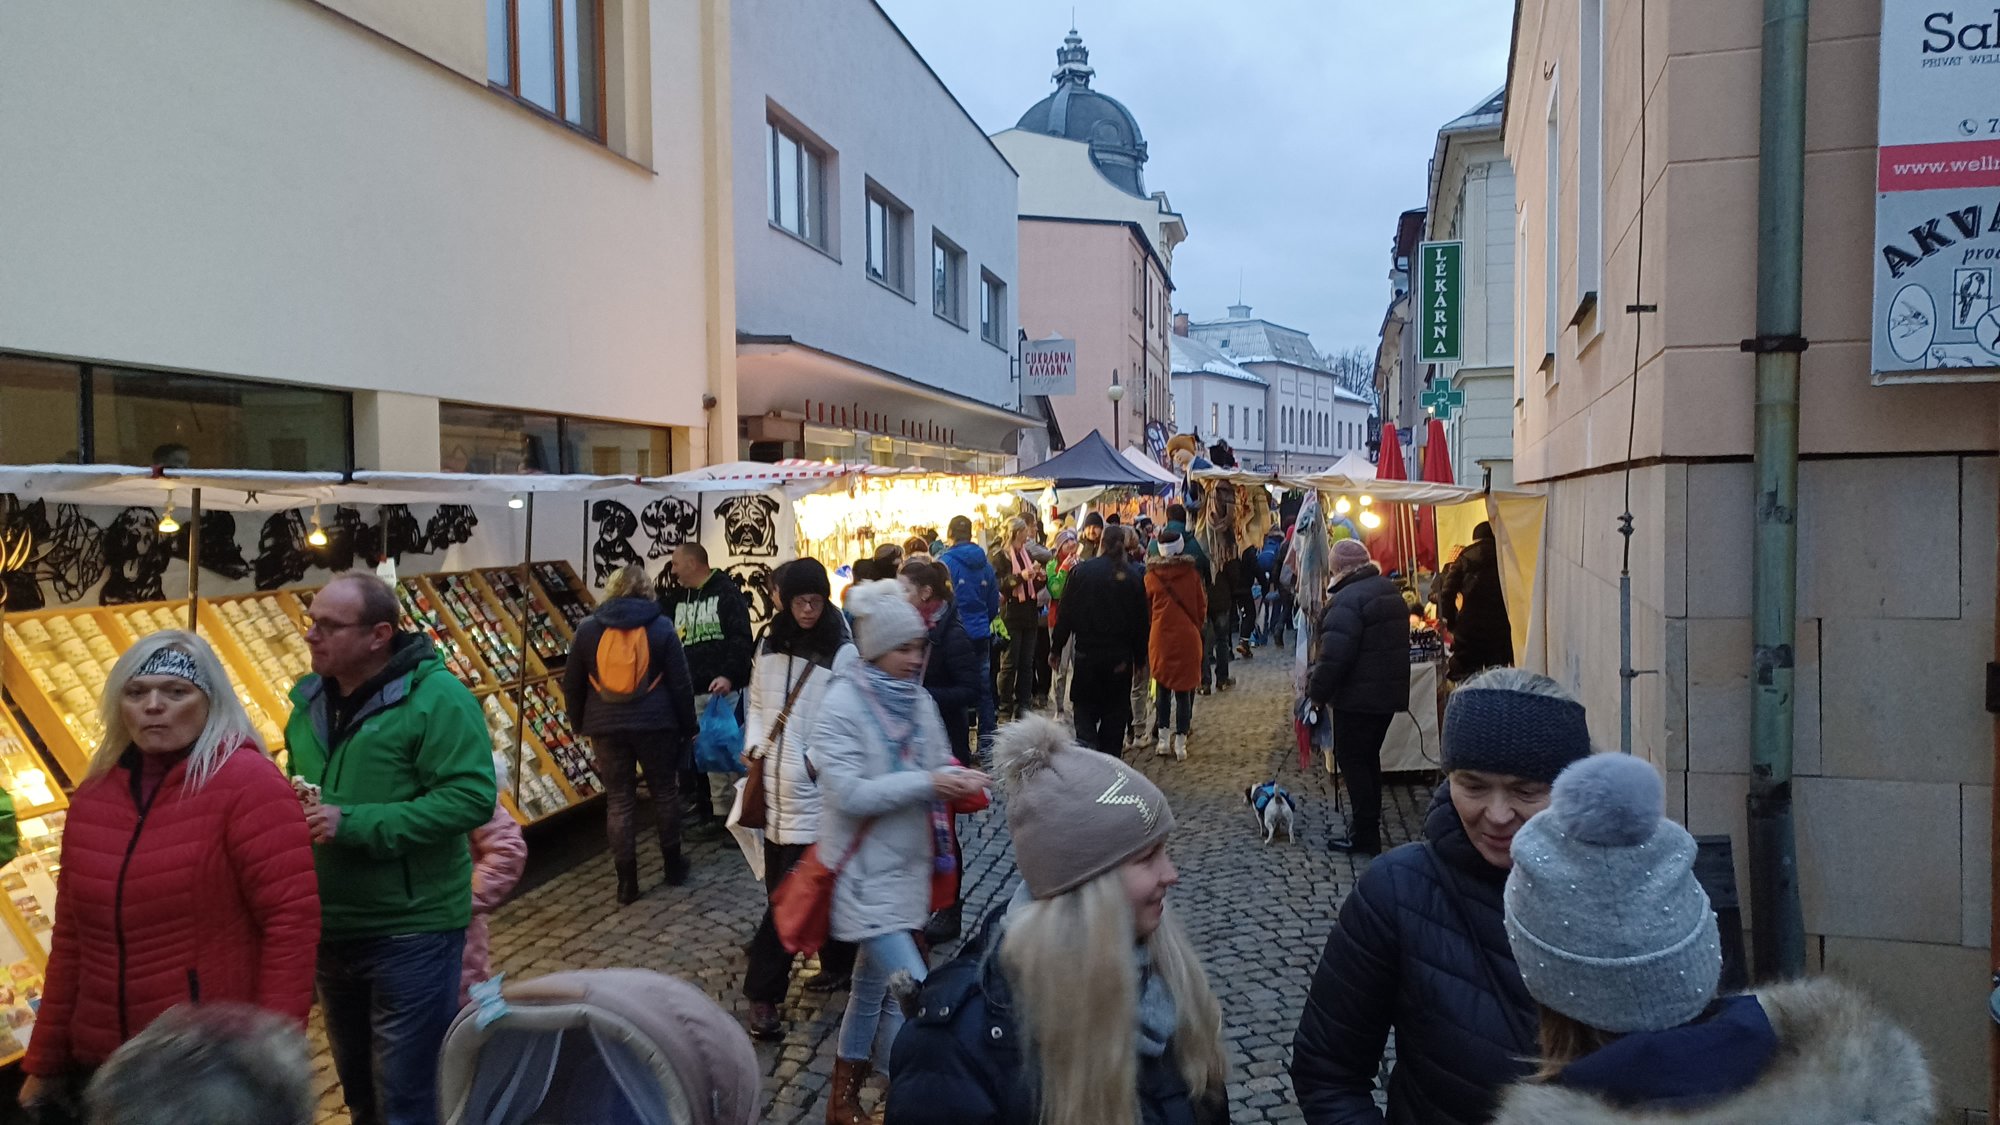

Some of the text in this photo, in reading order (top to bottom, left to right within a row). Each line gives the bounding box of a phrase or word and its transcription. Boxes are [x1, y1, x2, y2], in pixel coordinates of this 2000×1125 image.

[1922, 56, 1963, 68] PRIVAT
[1433, 248, 1448, 354] LÉKÁRNA
[1025, 350, 1072, 365] CUKRÁRNA
[1029, 363, 1068, 377] KAVÁRNA
